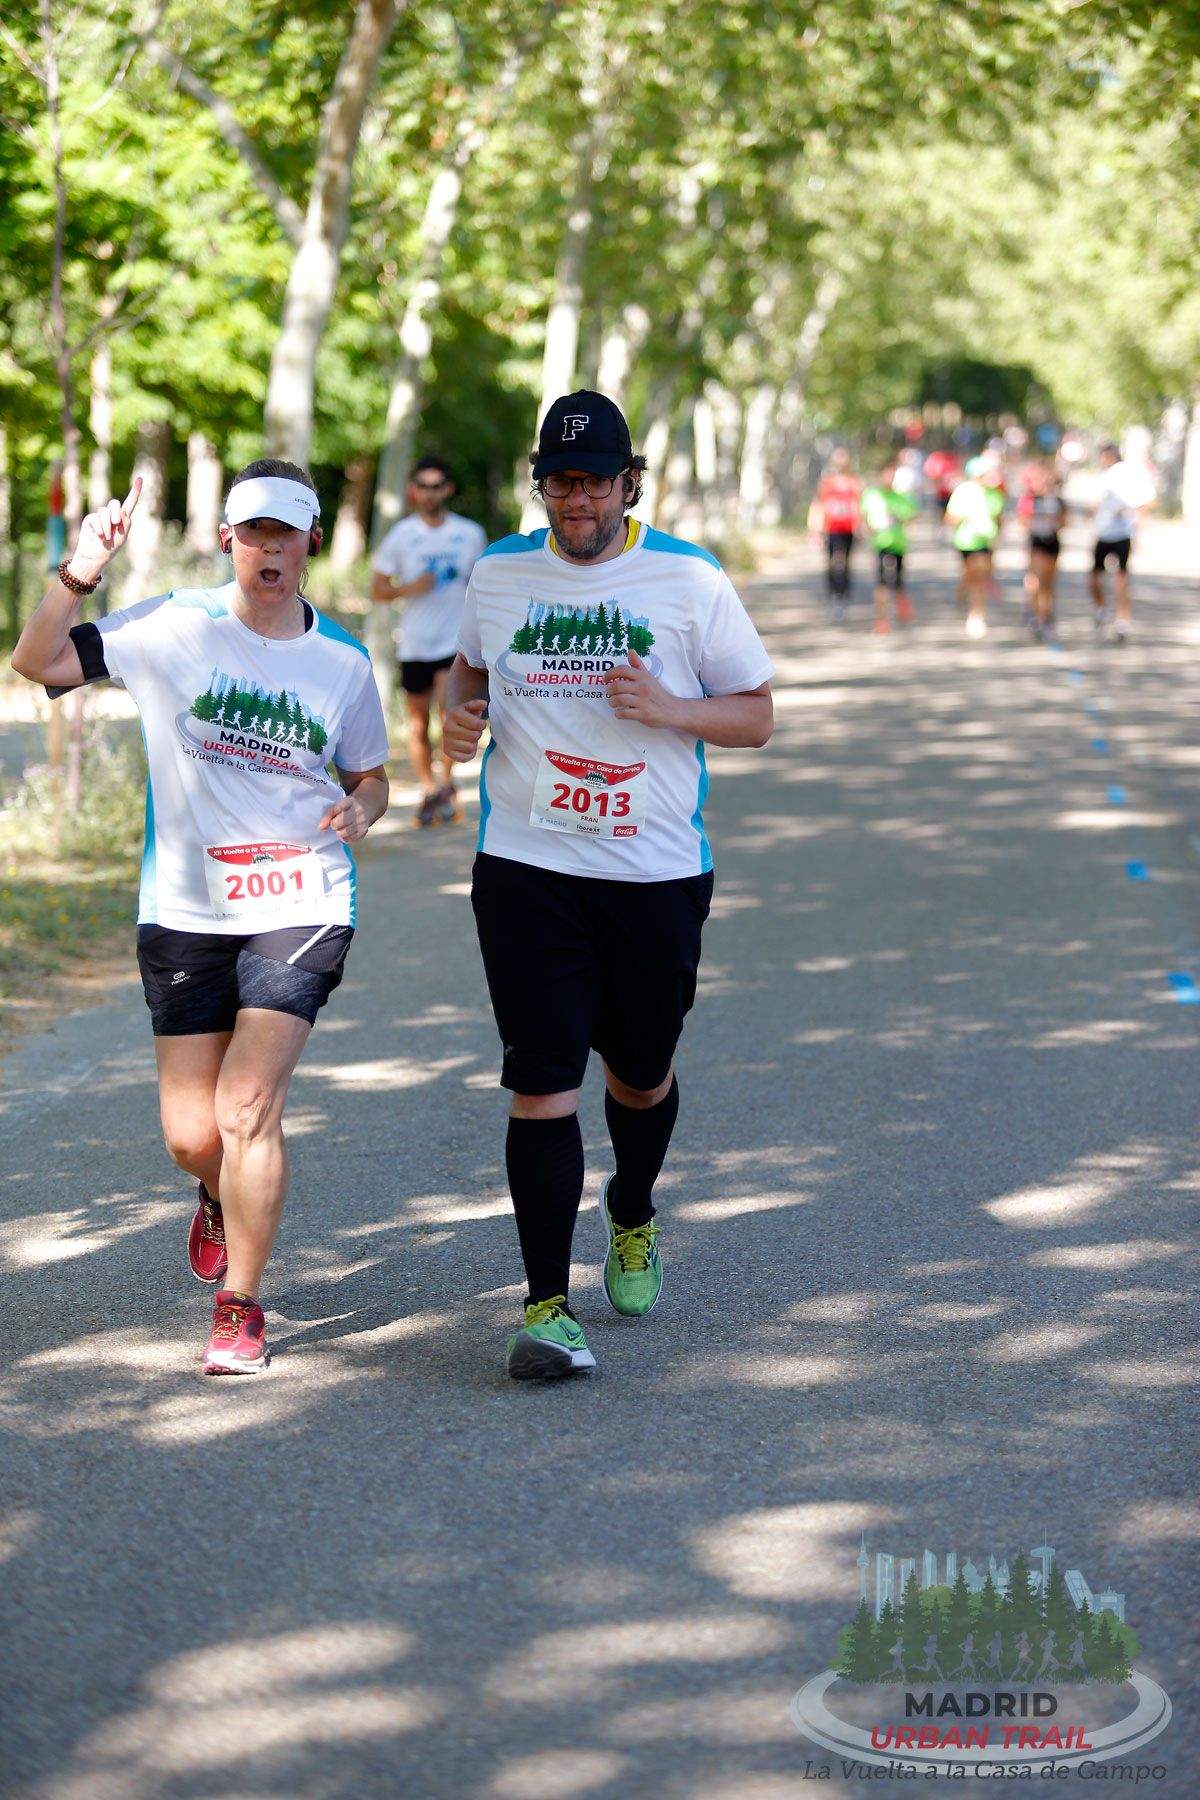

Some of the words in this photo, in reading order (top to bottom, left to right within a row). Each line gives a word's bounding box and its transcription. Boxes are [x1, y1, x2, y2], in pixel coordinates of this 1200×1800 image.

[562, 415, 589, 441] F
[542, 659, 615, 672] MADRID
[526, 673, 582, 684] URBAN
[515, 688, 550, 698] Vuelta
[562, 689, 572, 698] la
[575, 690, 602, 698] Casa
[204, 740, 258, 760] URBAN
[262, 755, 301, 772] TRAIL
[220, 730, 291, 759] MADRID
[191, 750, 225, 766] Vuelta
[236, 760, 246, 771] la
[248, 763, 274, 774] Casa
[560, 758, 580, 766] Vuelta
[596, 765, 612, 773] Casa
[550, 783, 631, 818] 2013
[225, 869, 303, 900] 2001
